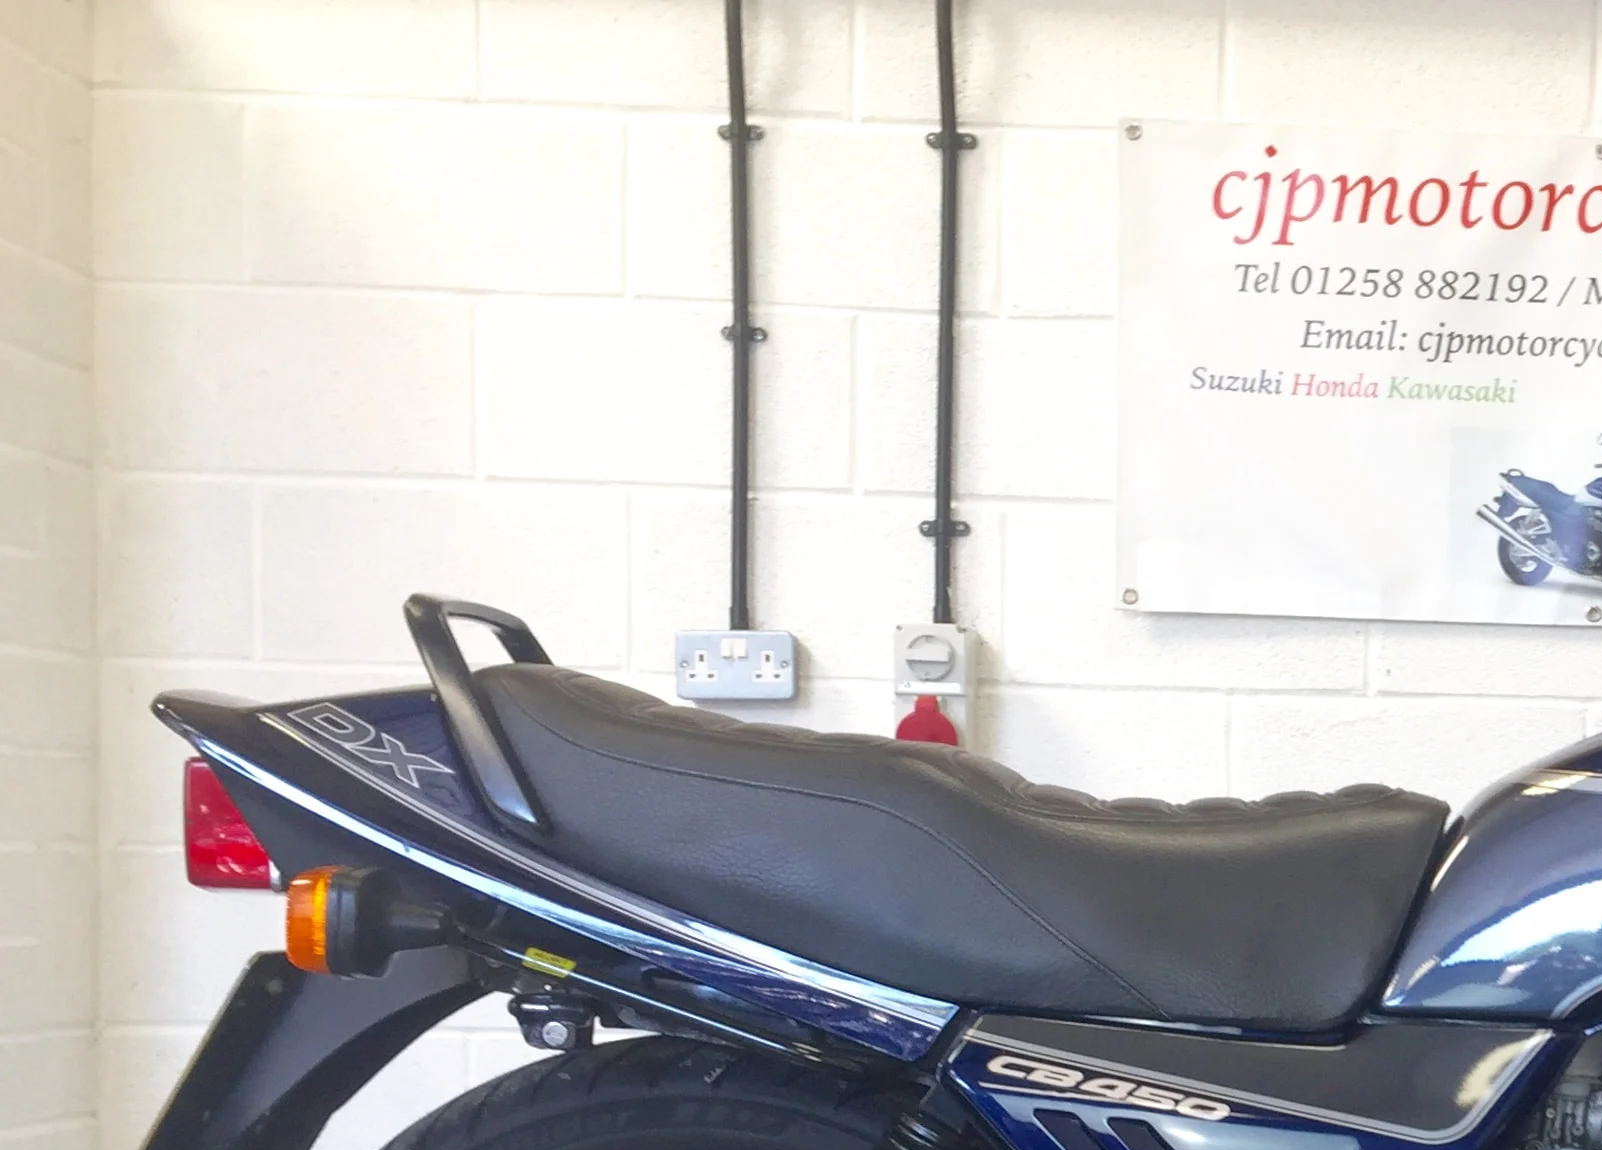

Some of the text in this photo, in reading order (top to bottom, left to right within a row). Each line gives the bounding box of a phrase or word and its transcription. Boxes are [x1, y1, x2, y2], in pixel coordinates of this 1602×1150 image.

[1234, 261, 1281, 294] Tel
[1290, 264, 1405, 299] 01258
[1413, 269, 1550, 304] 882192
[1556, 276, 1577, 308] /
[1300, 319, 1408, 352] Email:
[1189, 366, 1518, 404] Suzuki Honda Kawasaki
[286, 702, 457, 790] DX
